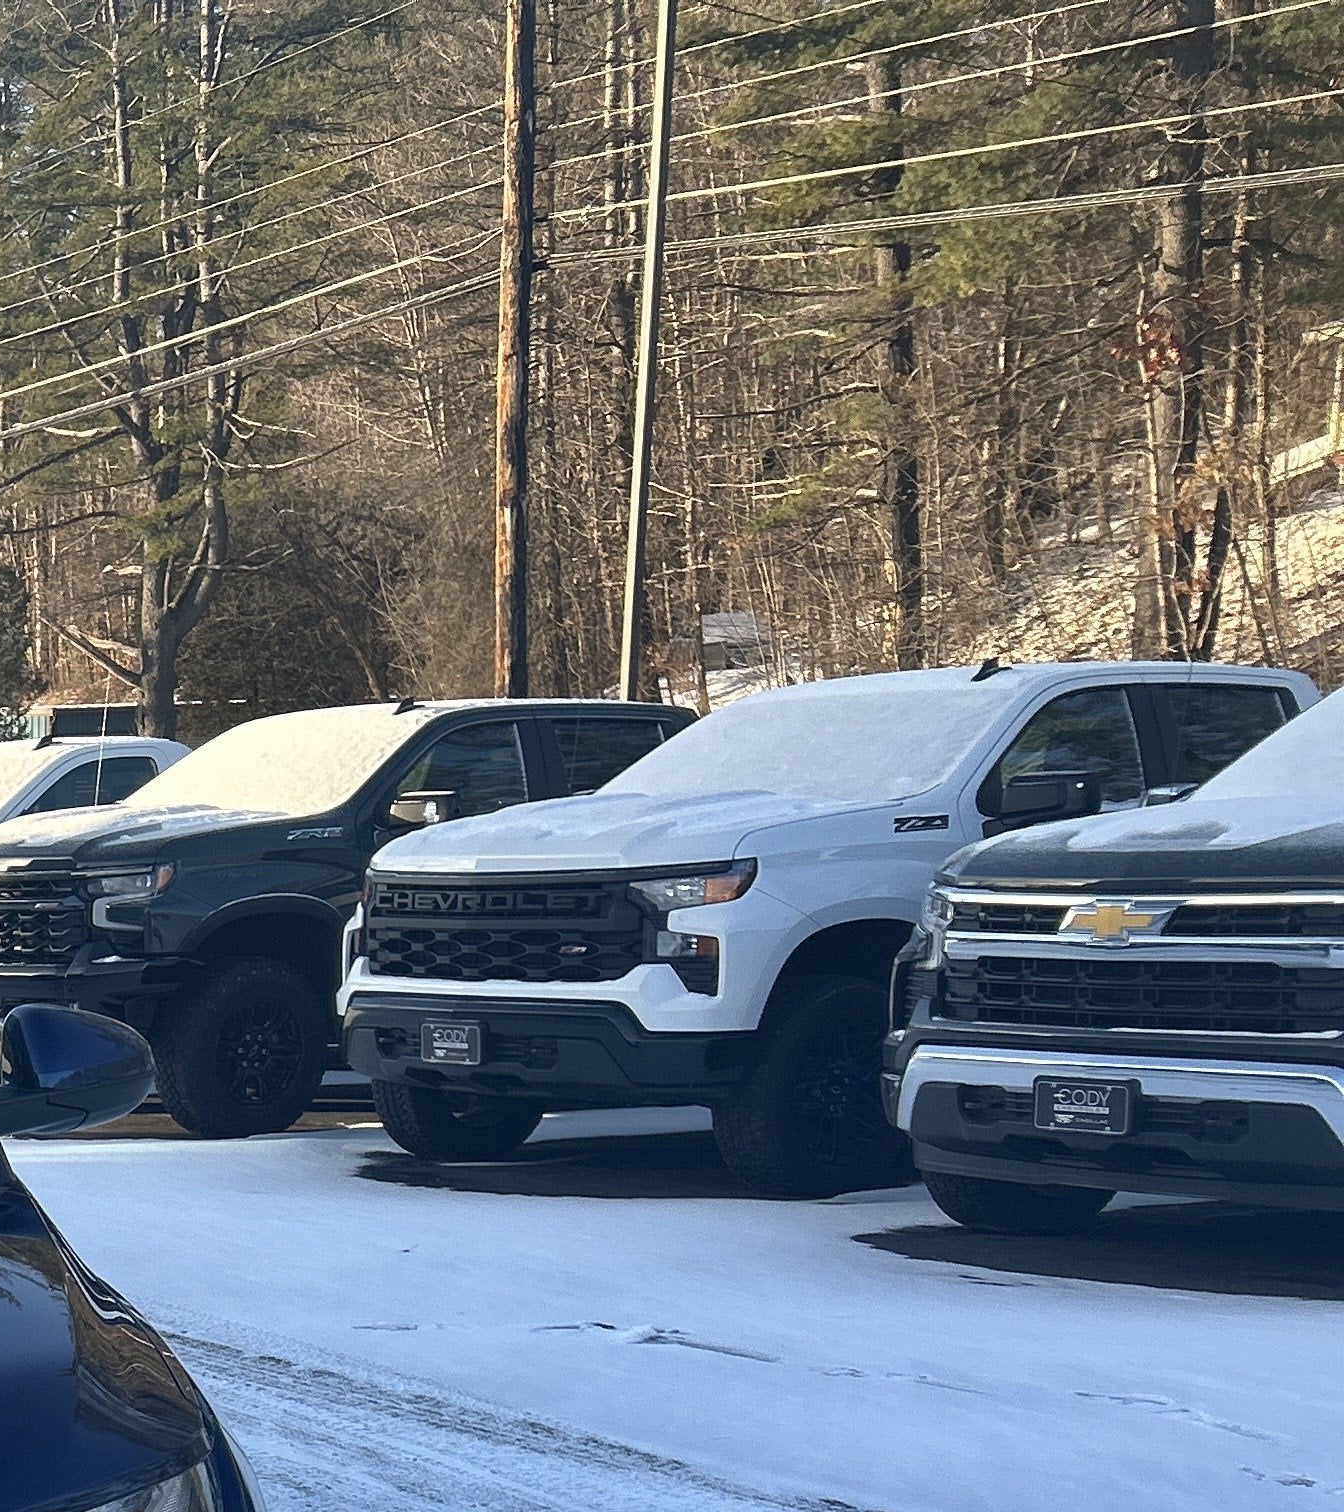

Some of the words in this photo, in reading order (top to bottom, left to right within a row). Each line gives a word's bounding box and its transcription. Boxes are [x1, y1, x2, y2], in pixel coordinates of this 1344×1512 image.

[376, 892, 600, 912] CHEVROLET
[434, 1028, 469, 1042] CODY
[1055, 1088, 1111, 1106] CODY
